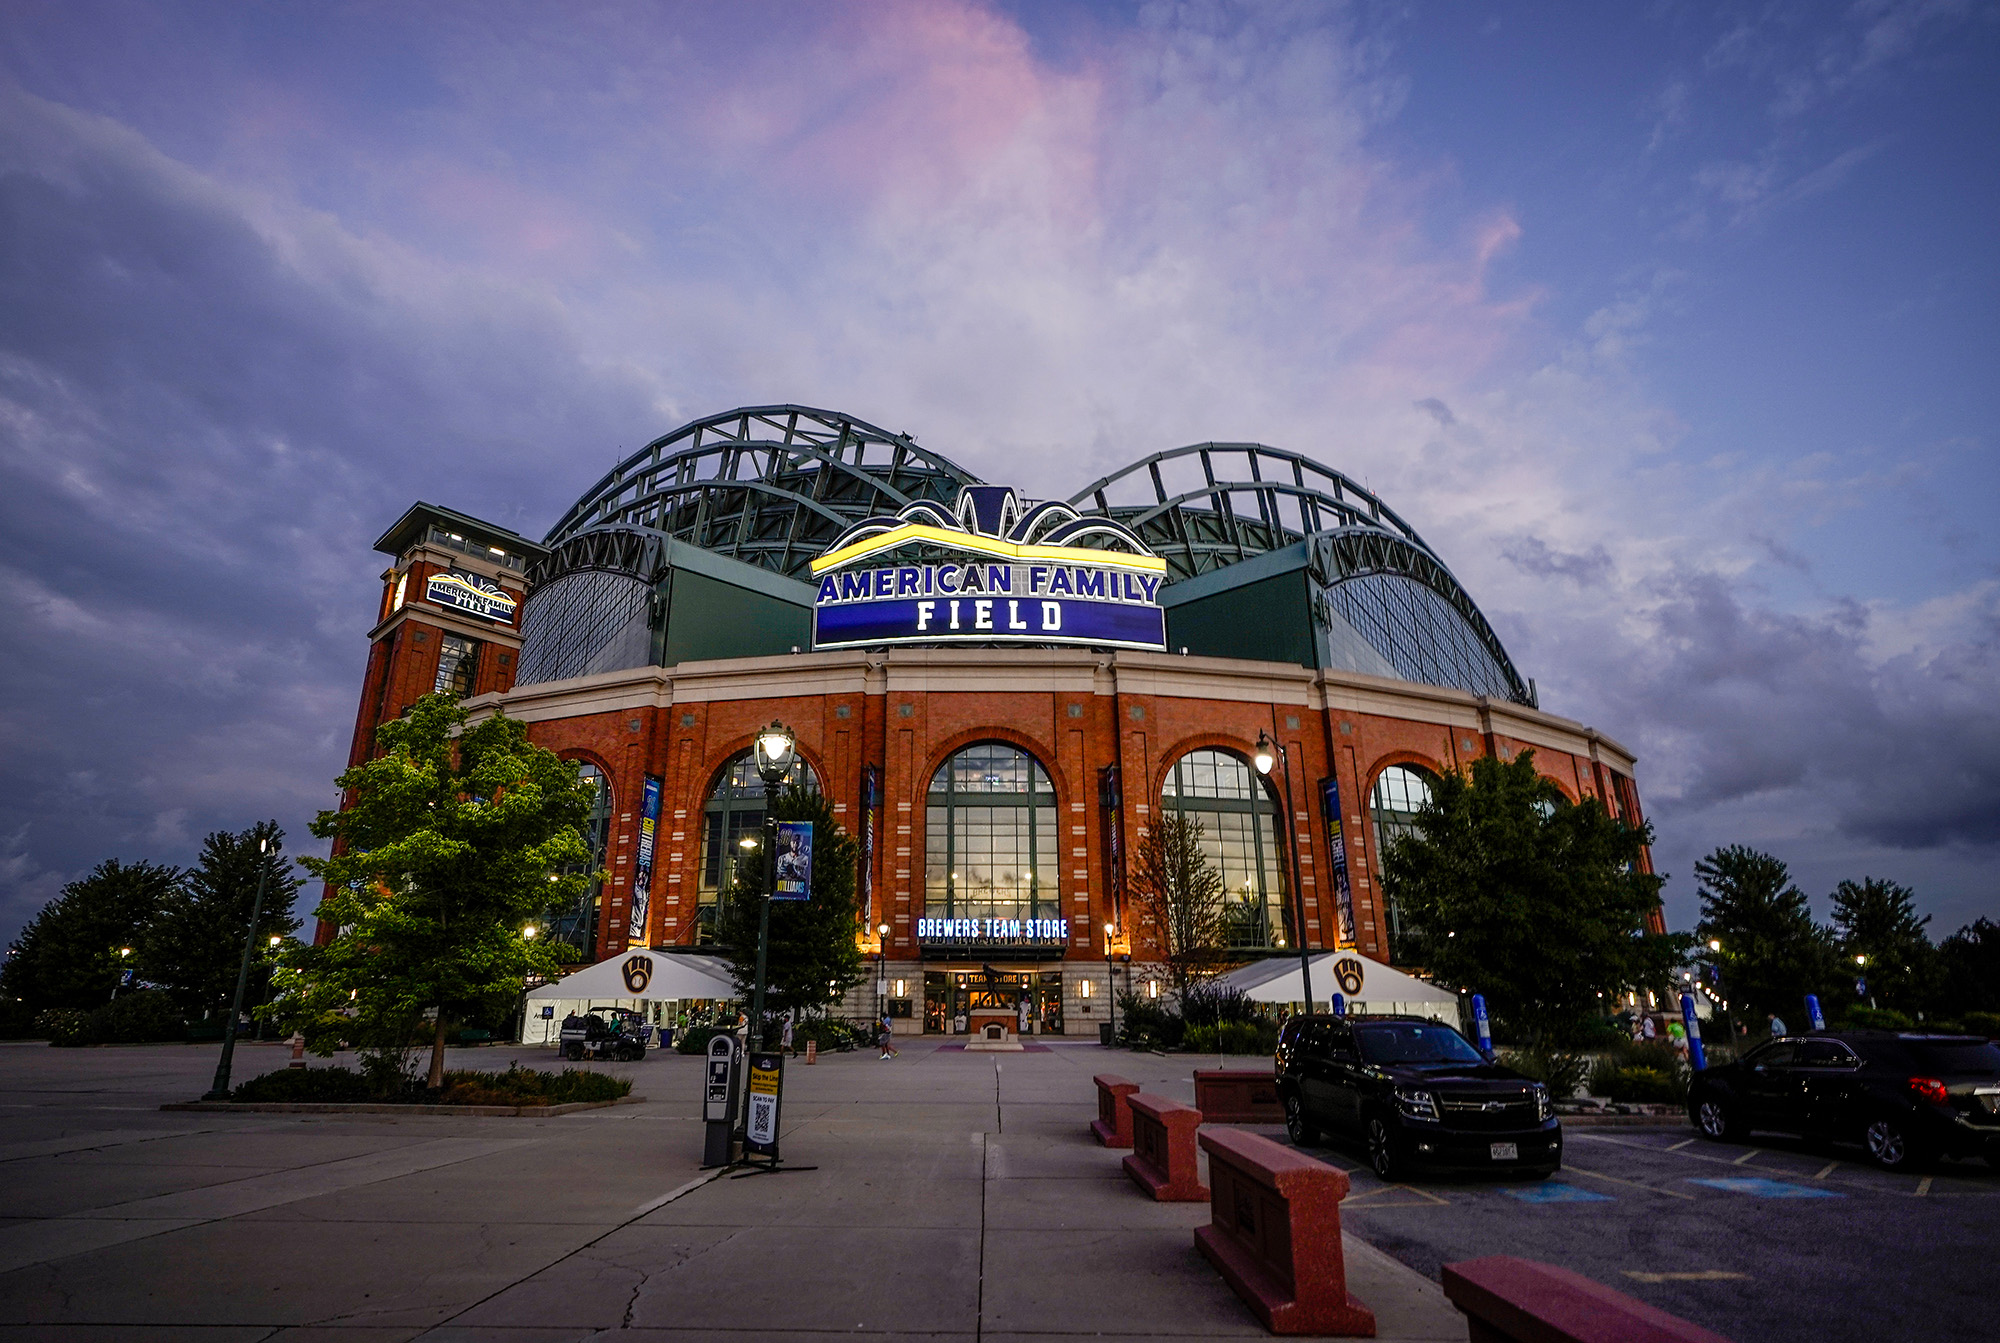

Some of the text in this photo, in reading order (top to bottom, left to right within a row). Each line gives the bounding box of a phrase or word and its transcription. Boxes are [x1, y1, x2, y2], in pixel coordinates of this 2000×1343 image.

[429, 582, 516, 614] AMERICAN FAMILY
[816, 564, 1162, 605] AMERICAN FAMILY
[455, 595, 491, 614] FIELD
[916, 600, 1062, 631] FIELD
[639, 817, 654, 867] CONTRERAS
[1330, 820, 1345, 869] MITCHELL
[777, 880, 805, 893] WILLIAMS
[918, 918, 1068, 938] BREWERS TEAM STORE
[753, 1073, 761, 1081] Skip
